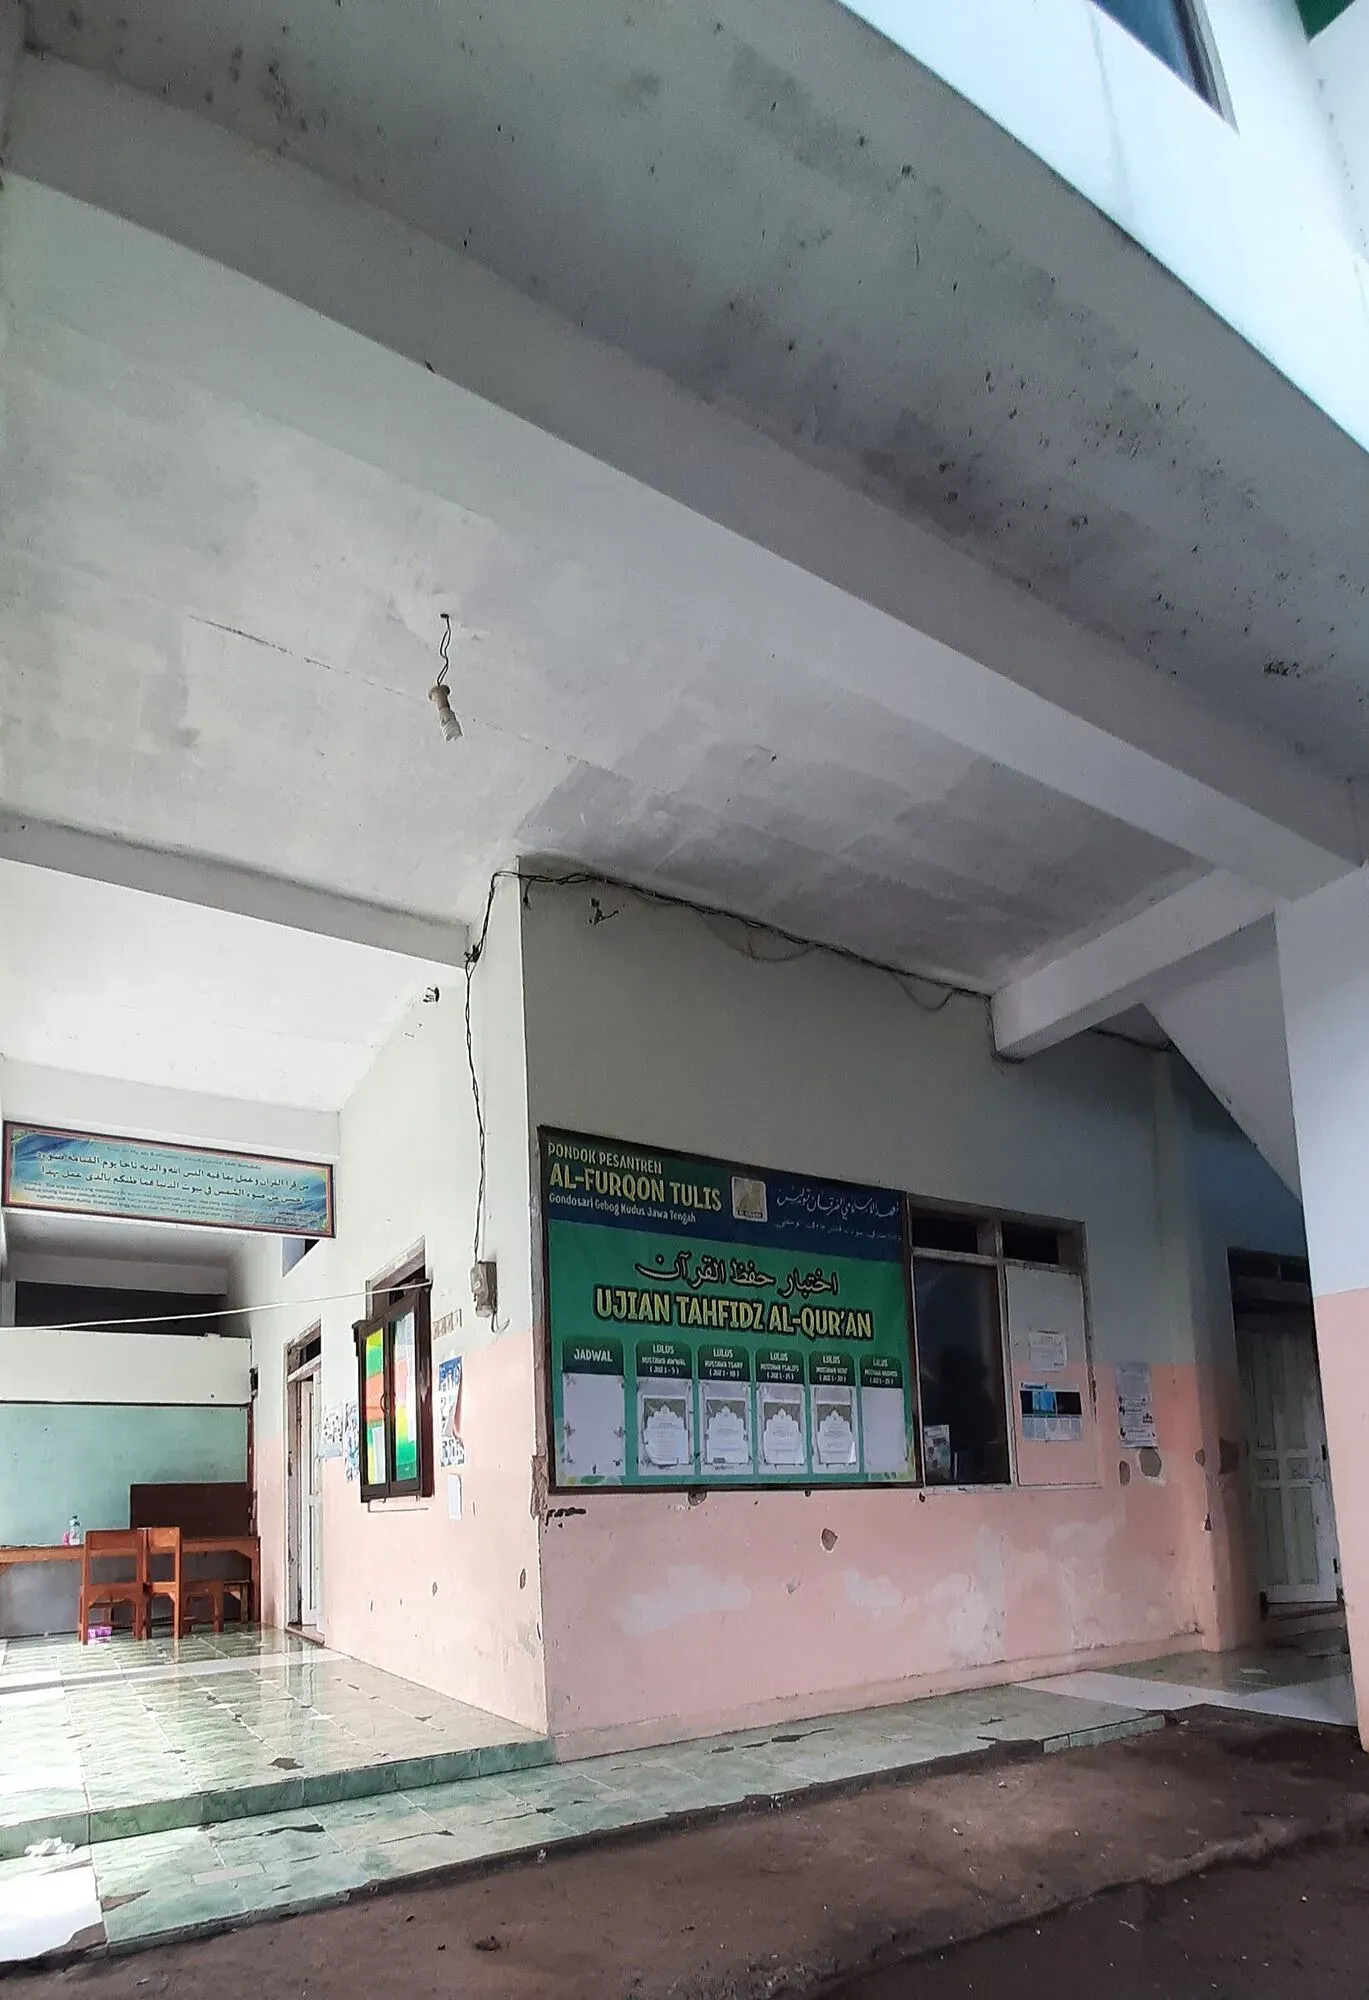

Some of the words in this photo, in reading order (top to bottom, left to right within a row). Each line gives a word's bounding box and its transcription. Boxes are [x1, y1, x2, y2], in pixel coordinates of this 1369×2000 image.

[548, 1142, 596, 1164] PONDOK
[599, 1151, 663, 1175] PESANTREN
[550, 1162, 666, 1203] AL-FURQON
[669, 1181, 722, 1212] TULIS
[549, 1192, 594, 1209] Gondosari
[595, 1199, 620, 1217] Gebog
[621, 1203, 646, 1216] Kudus
[647, 1207, 669, 1220] Jawa
[669, 1210, 697, 1226] Tengah
[635, 1250, 725, 1288] القرآن
[730, 1258, 775, 1287] حفظ
[779, 1268, 838, 1297] اختبار
[596, 1287, 670, 1323] UJIAN
[675, 1295, 764, 1330] TAHFIDZ
[768, 1305, 873, 1339] AL-QUR'AN
[573, 1348, 613, 1363] JADWAL
[652, 1344, 675, 1355] LULUS
[713, 1348, 734, 1358] LULUS
[770, 1352, 789, 1362] LULUS
